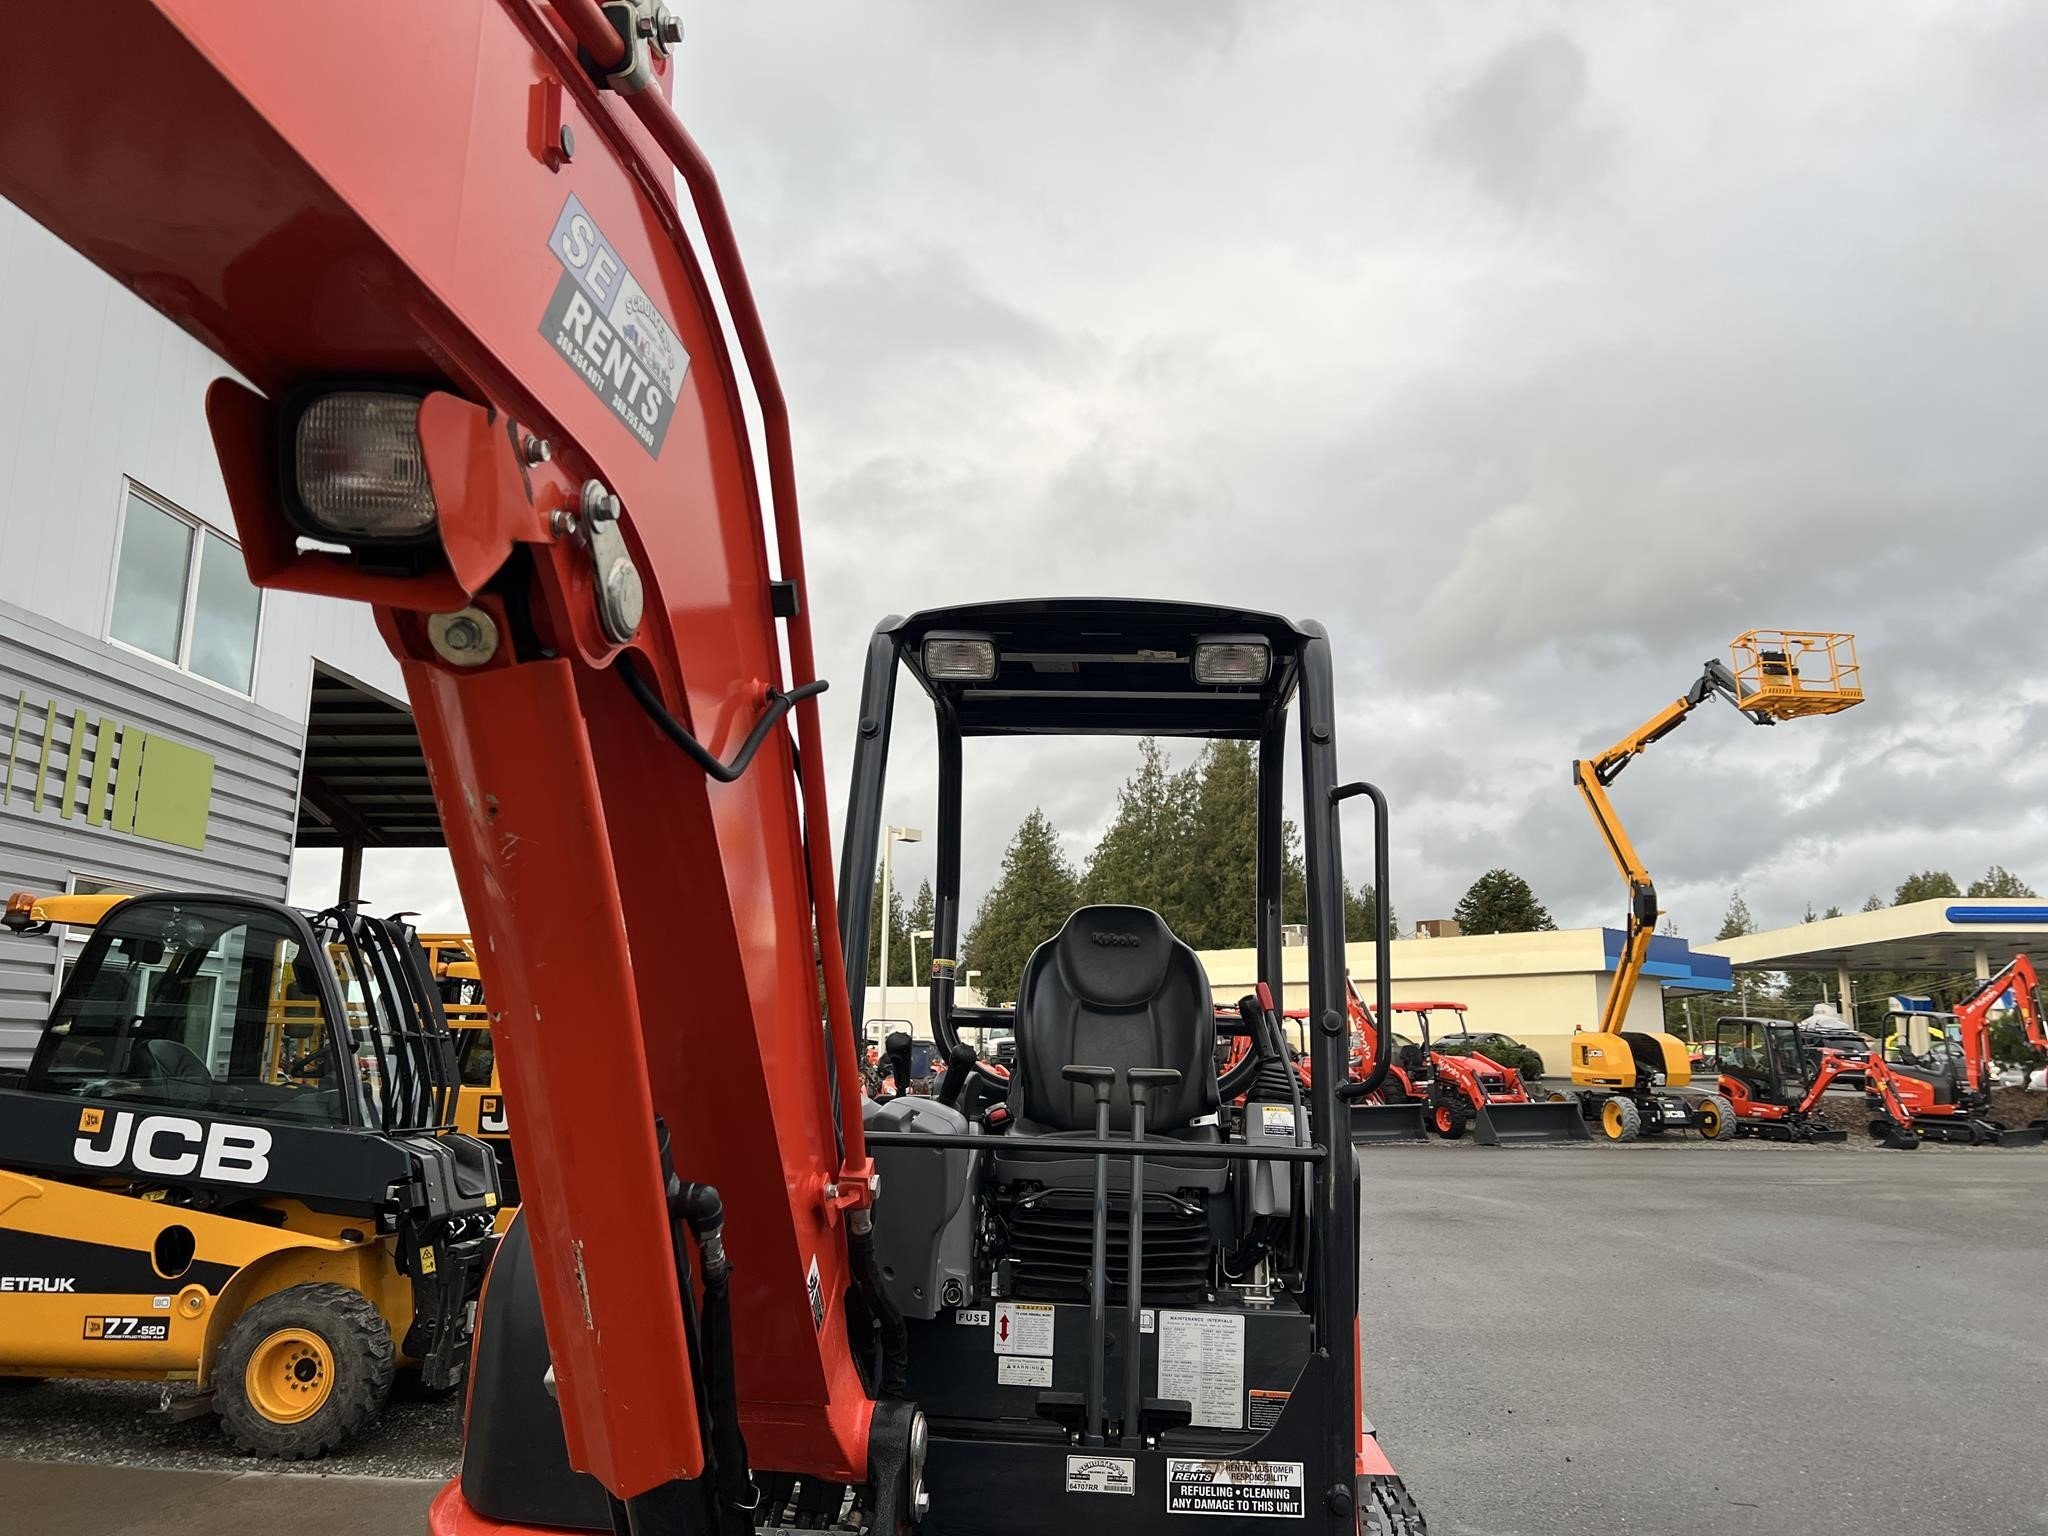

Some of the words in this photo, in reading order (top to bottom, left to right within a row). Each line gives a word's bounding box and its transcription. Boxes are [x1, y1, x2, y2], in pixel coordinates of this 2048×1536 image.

[562, 213, 619, 303] SE
[561, 289, 662, 425] RENTS
[1355, 1016, 1371, 1060] Kubota
[74, 1112, 272, 1184] JCB
[0, 1276, 76, 1292] ETRUK
[958, 1313, 987, 1323] FUSE
[1174, 1463, 1190, 1472] SE
[1226, 1464, 1252, 1473] RENTAL
[1254, 1465, 1294, 1474] CUSTOMER
[1175, 1472, 1212, 1482] RENTS
[1180, 1485, 1233, 1497] REFUELING
[1243, 1487, 1290, 1499] CLEANING
[1172, 1498, 1192, 1509] ANY
[1194, 1499, 1234, 1510] DAMAGE
[1237, 1500, 1252, 1511] TO
[1253, 1501, 1274, 1512] THIS
[1276, 1502, 1299, 1513] UNIT
